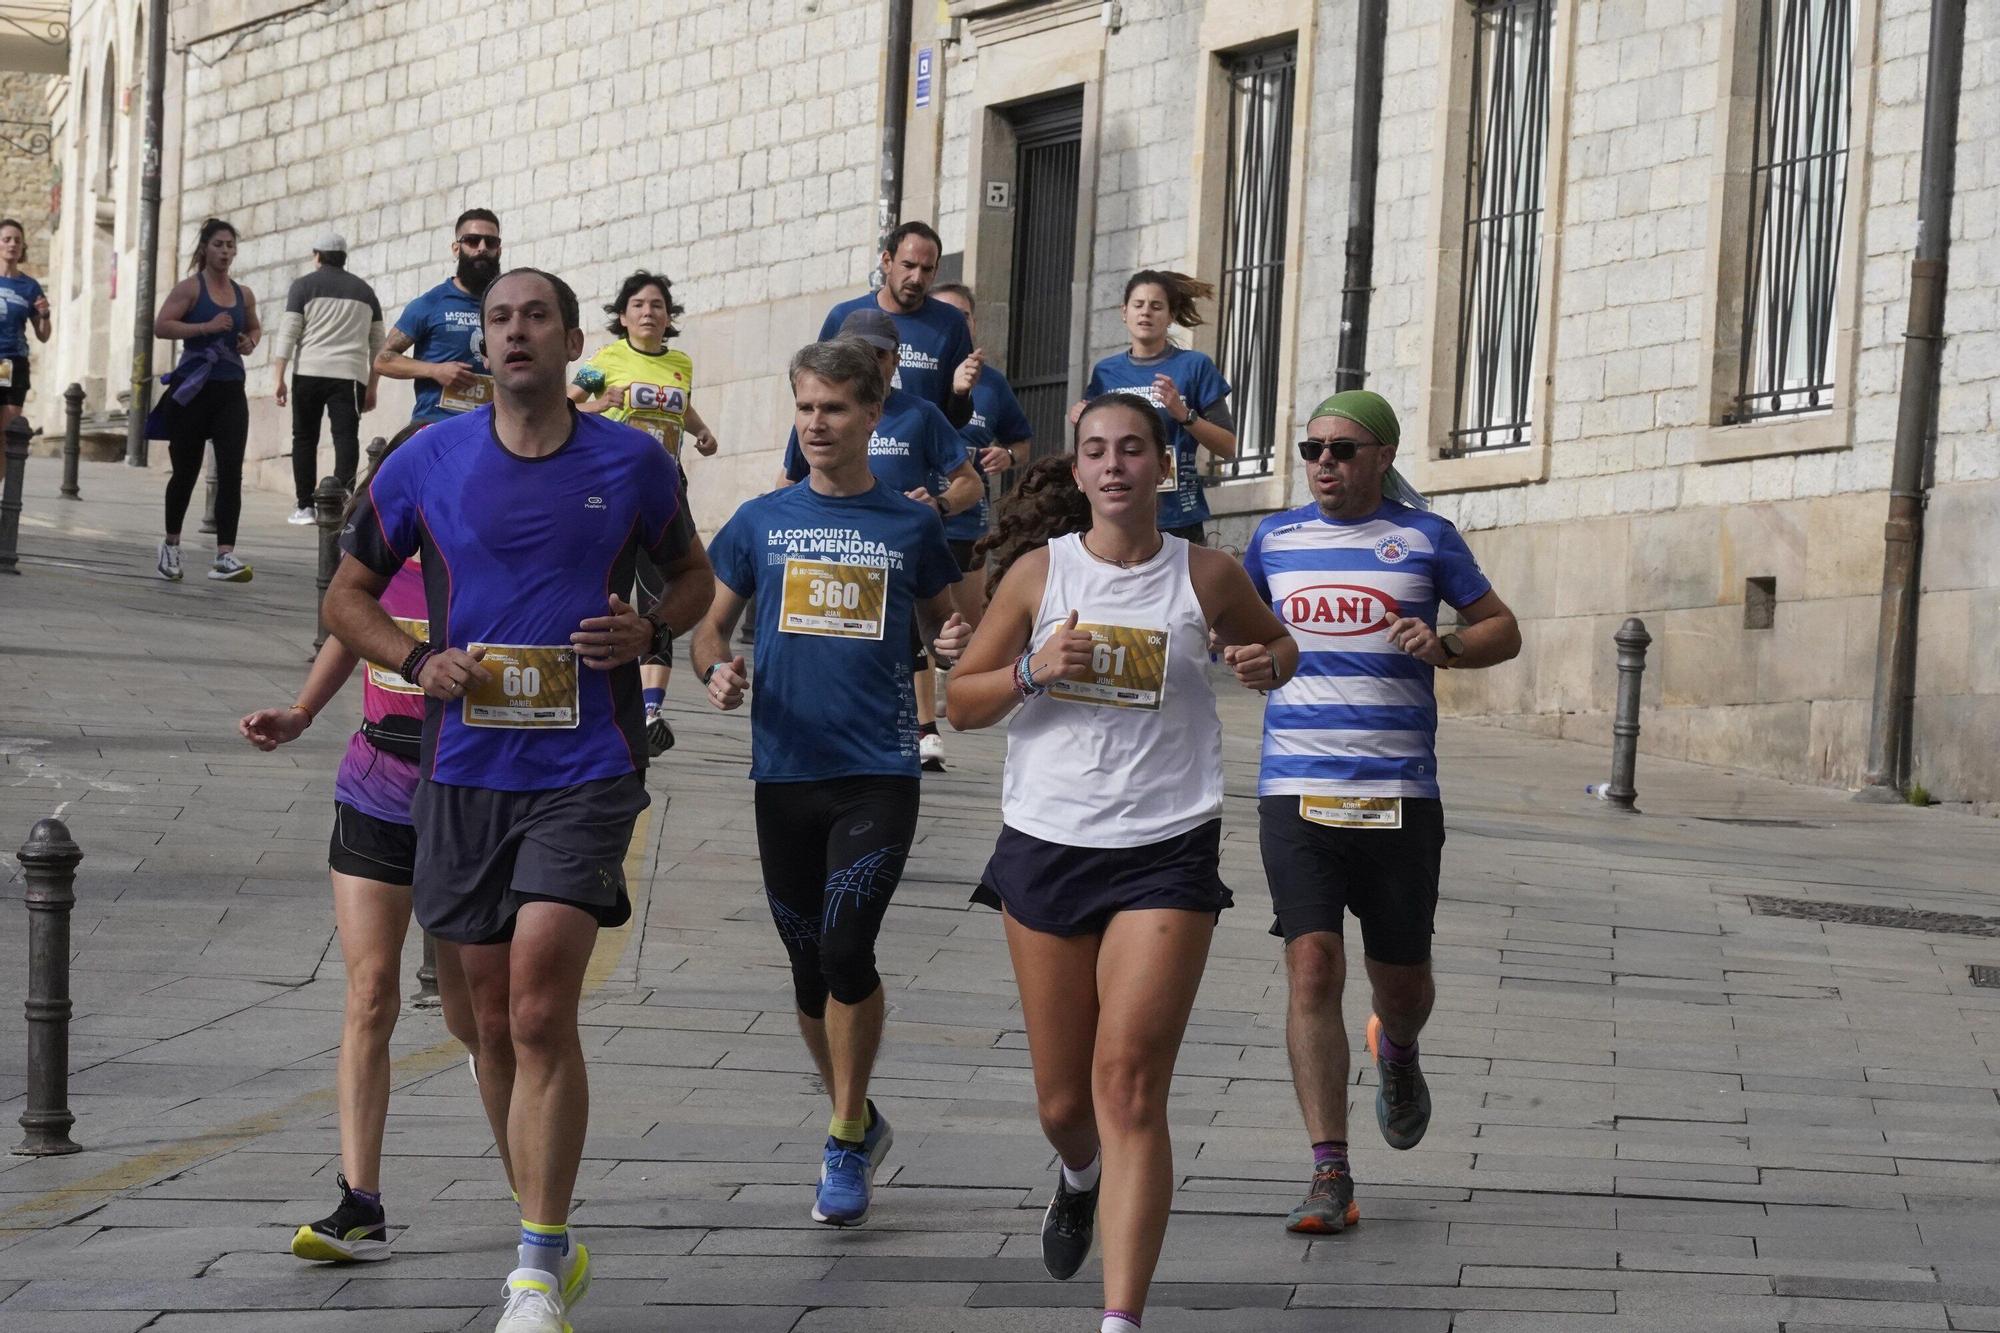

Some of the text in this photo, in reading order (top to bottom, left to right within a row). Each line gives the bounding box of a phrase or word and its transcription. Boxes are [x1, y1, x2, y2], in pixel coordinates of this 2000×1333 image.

[898, 351, 929, 361] NDRA
[899, 360, 938, 370] KONKISTA
[768, 528, 861, 540] LA CONQUISTA
[786, 539, 888, 556] ALMENDRA
[889, 550, 904, 559] REN
[868, 572, 880, 581] 10K
[808, 579, 860, 610] 360
[824, 610, 841, 618] JUAN
[1291, 597, 1374, 624] DANI
[1147, 635, 1162, 645] 10K
[1092, 643, 1126, 676] 61
[503, 666, 540, 697] 60
[1096, 677, 1115, 685] JUNE
